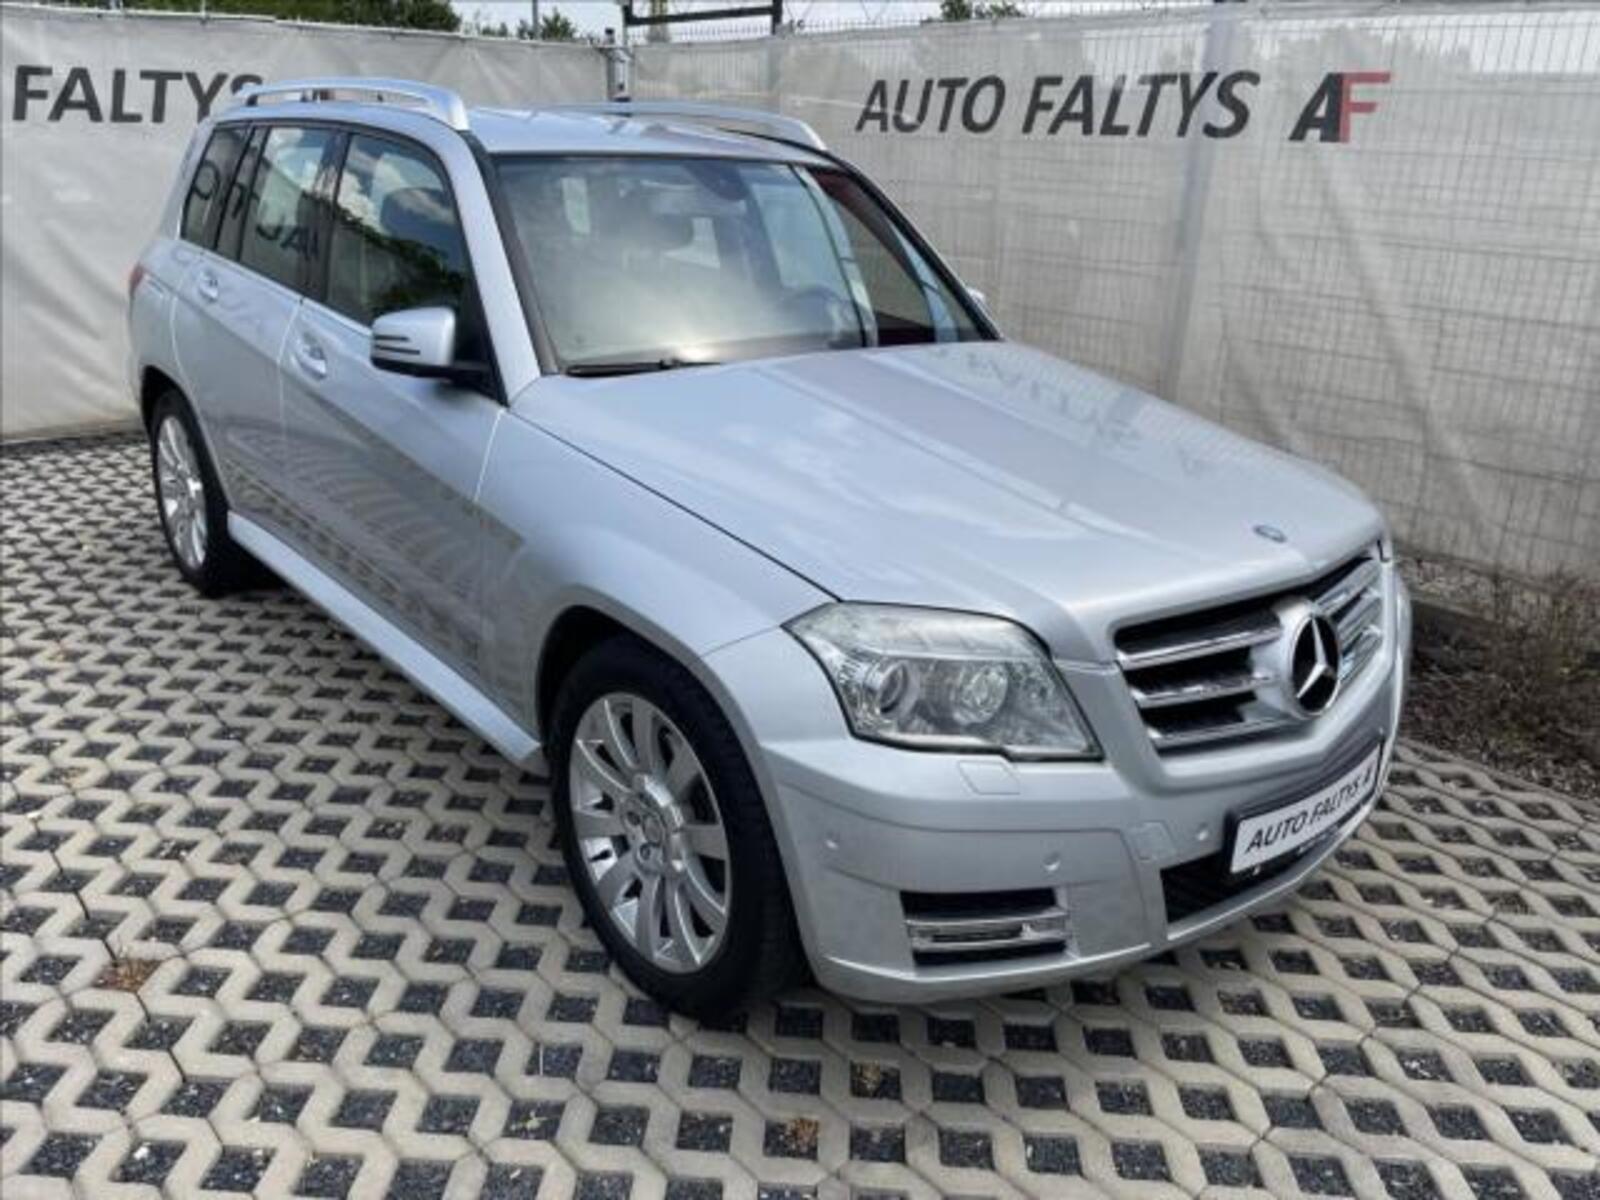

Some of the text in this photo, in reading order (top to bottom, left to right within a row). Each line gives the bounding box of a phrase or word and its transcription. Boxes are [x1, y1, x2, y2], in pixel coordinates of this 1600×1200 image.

[856, 70, 1392, 143] AUTO FALTYS AF
[1245, 810, 1308, 854] AUTO
